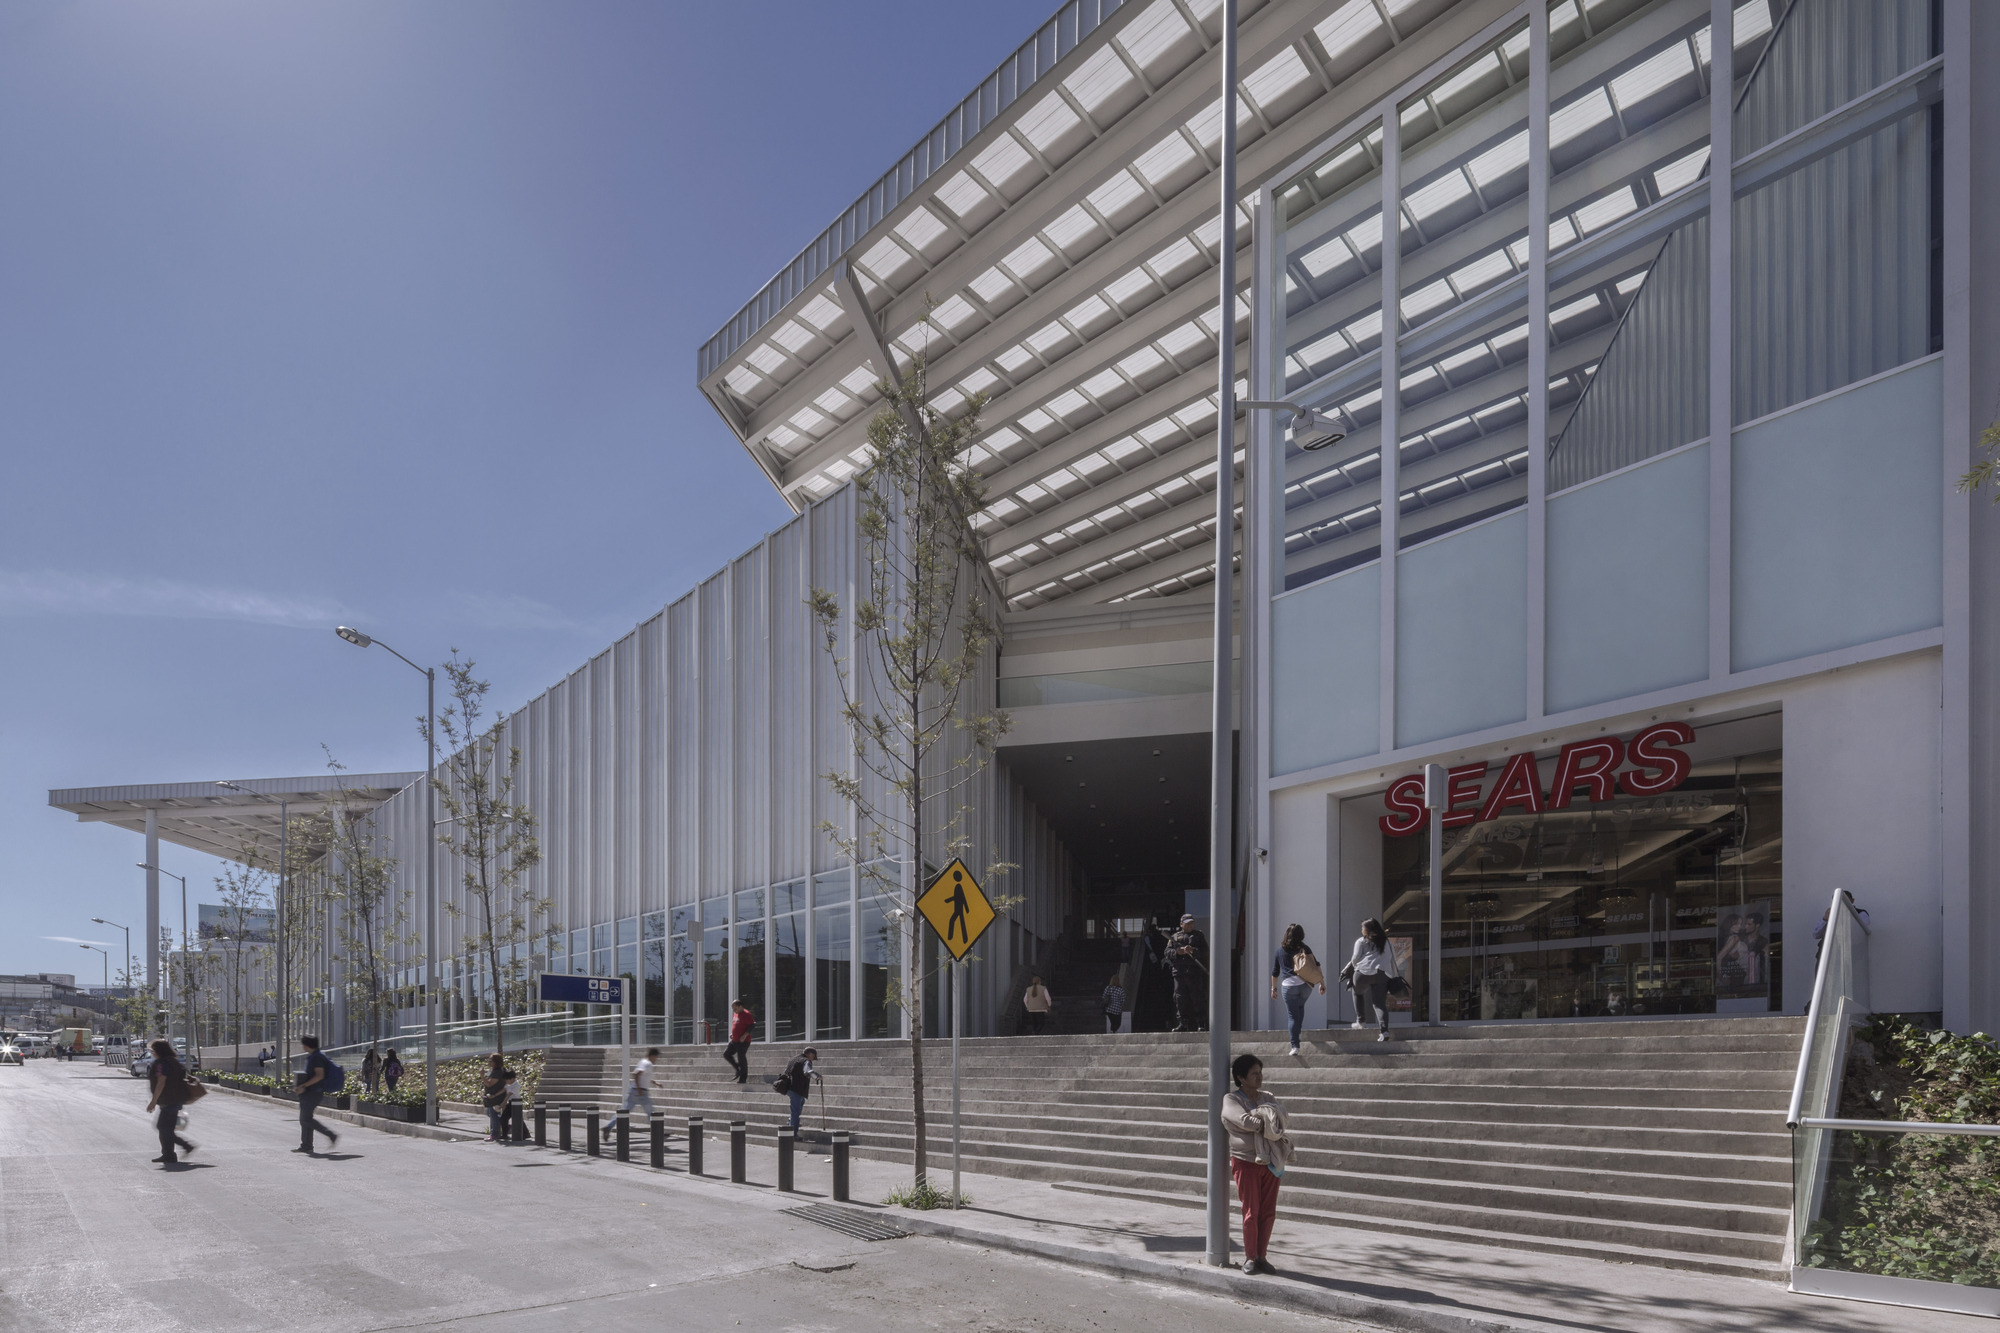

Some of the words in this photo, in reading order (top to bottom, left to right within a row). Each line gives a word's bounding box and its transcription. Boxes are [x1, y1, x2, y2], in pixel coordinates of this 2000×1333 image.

[1379, 721, 1696, 837] SEARS
[1610, 793, 1713, 823] SEARS
[1442, 822, 1522, 849] SEARS
[1675, 905, 1718, 917] SEARS
[1606, 912, 1645, 923] SEARS
[1441, 929, 1467, 938] EARS
[1491, 924, 1526, 934] SEARS
